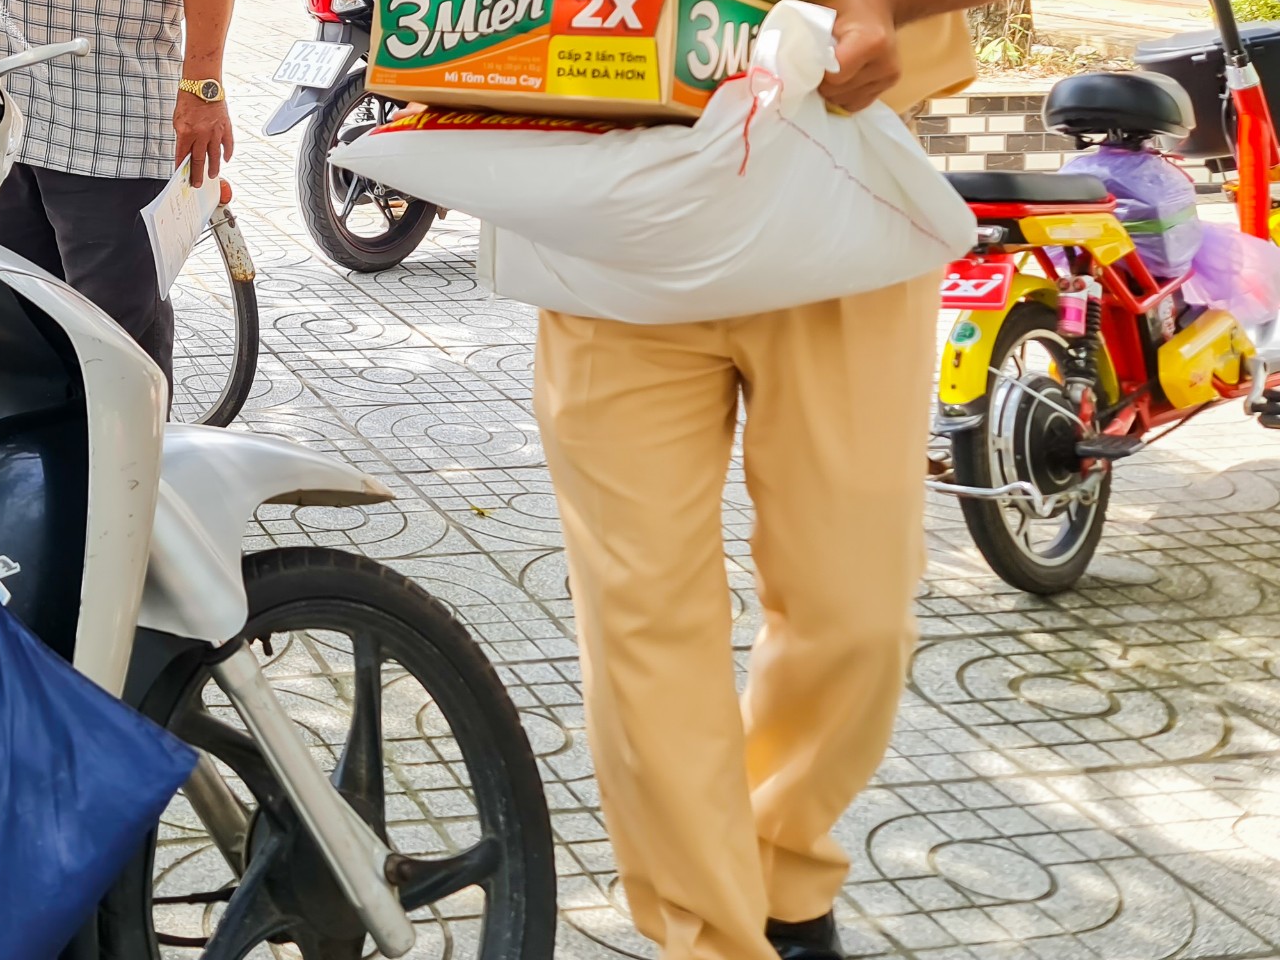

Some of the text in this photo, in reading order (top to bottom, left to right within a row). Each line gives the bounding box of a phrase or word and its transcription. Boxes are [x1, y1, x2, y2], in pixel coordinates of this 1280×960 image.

[557, 48, 582, 63] Gấp
[585, 51, 592, 61] 2
[619, 50, 647, 63] Tôm
[278, 62, 332, 85] 303.14
[487, 73, 517, 84] Chua
[519, 74, 542, 89] Cay
